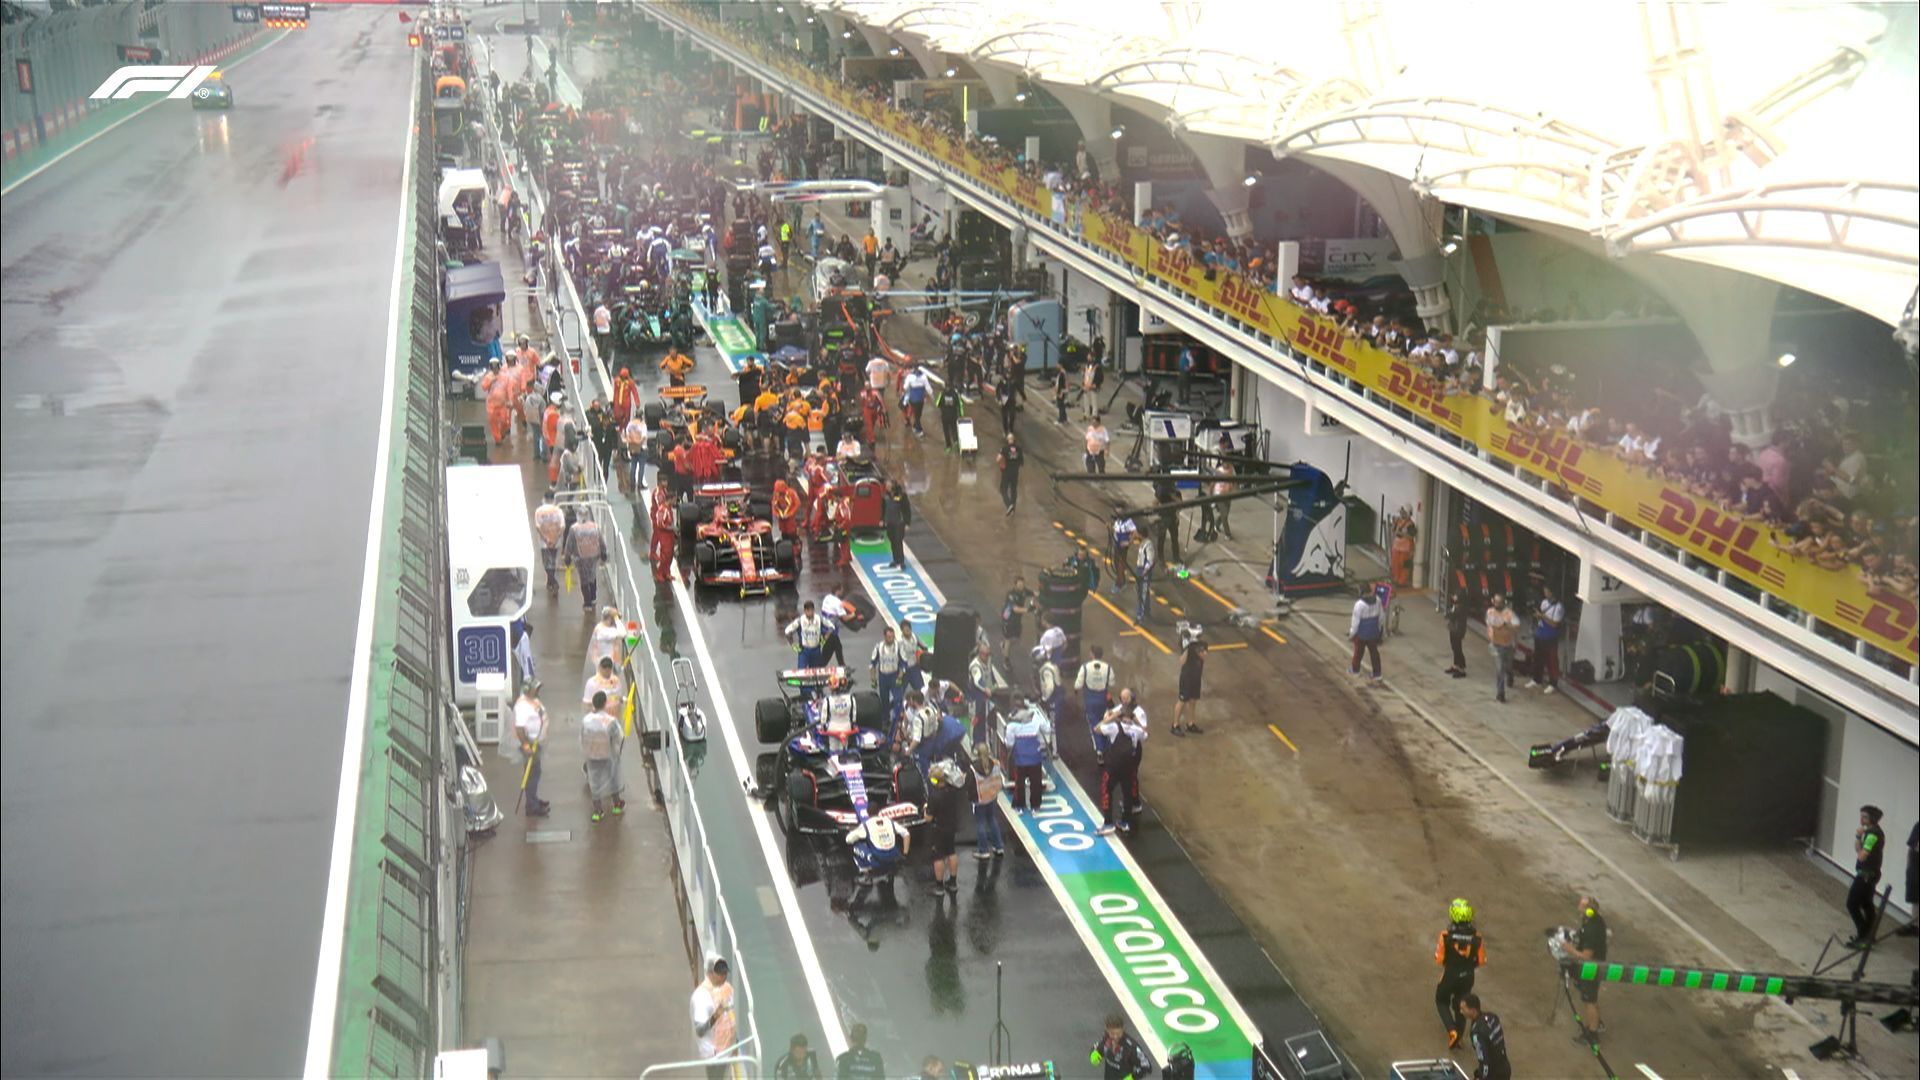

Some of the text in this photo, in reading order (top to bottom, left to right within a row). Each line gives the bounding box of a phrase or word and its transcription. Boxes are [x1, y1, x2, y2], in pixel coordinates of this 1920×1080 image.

[1328, 252, 1377, 263] CITY
[1220, 280, 1262, 322] DHL
[1296, 315, 1346, 366] DHL
[1389, 361, 1452, 420] DHL
[1504, 420, 1587, 486] DHL
[1656, 487, 1764, 575] DHL
[872, 563, 938, 624] aramco
[464, 634, 500, 664] 30
[466, 666, 499, 675] LAWSON
[1089, 893, 1220, 1034] aramco
